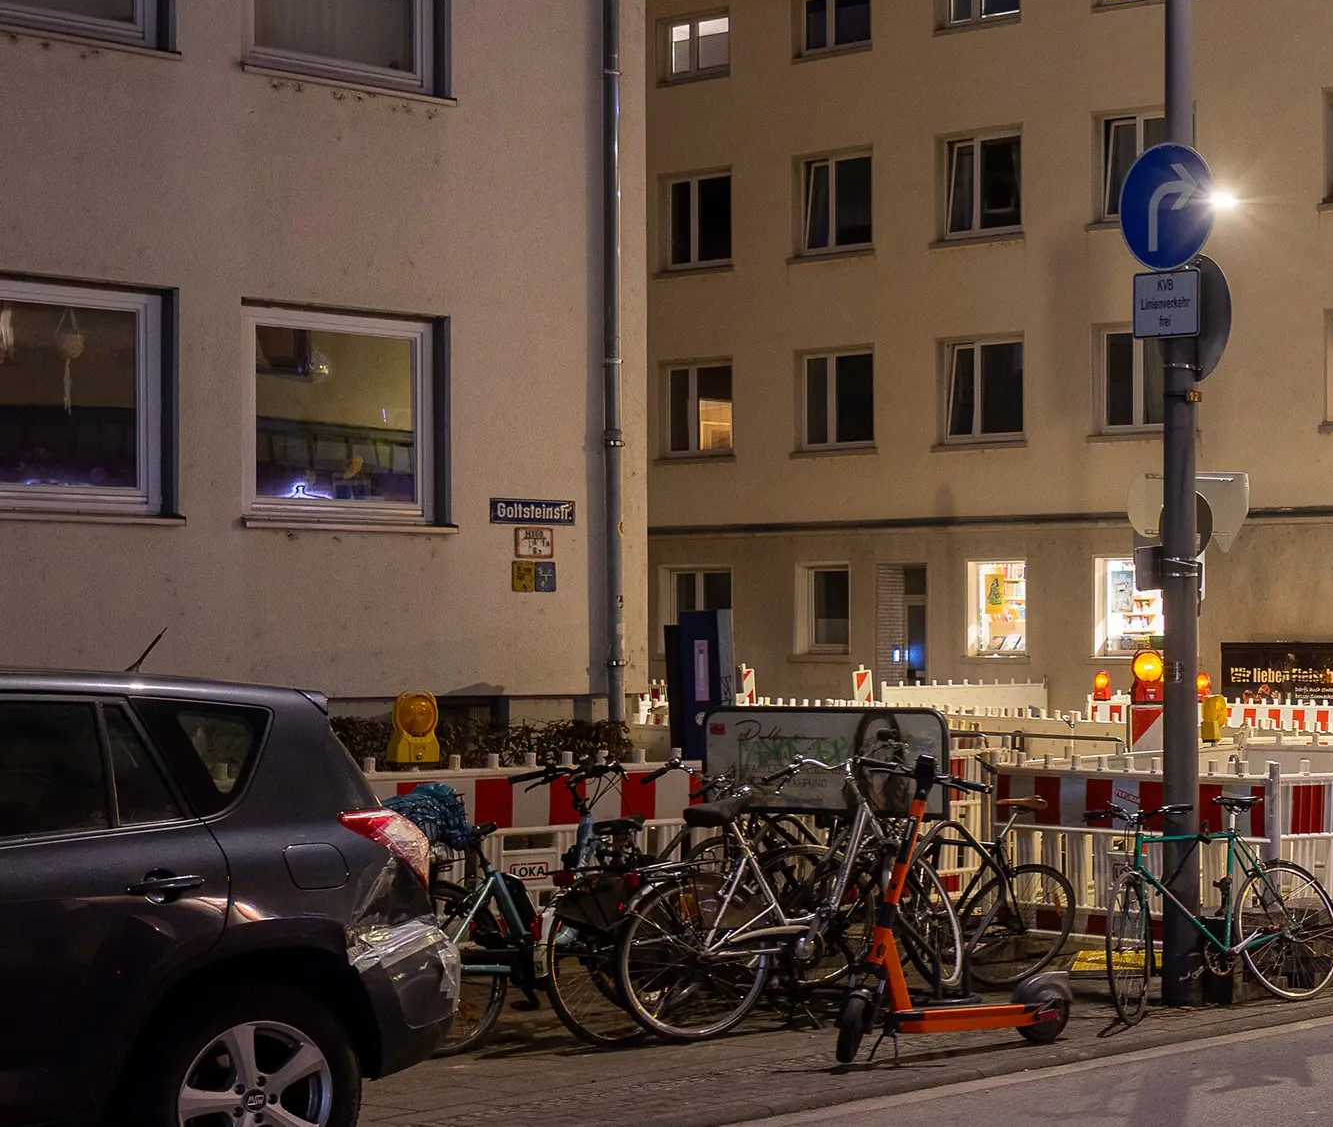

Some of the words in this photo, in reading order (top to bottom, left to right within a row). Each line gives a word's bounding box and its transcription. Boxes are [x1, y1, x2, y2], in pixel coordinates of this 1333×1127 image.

[1157, 278, 1174, 292] KVB
[1140, 296, 1191, 311] Linienverkehr
[1159, 315, 1172, 327] frei
[497, 502, 573, 521] Goltsteinstr.
[1230, 667, 1251, 683] Wir
[1253, 667, 1290, 683] lieben
